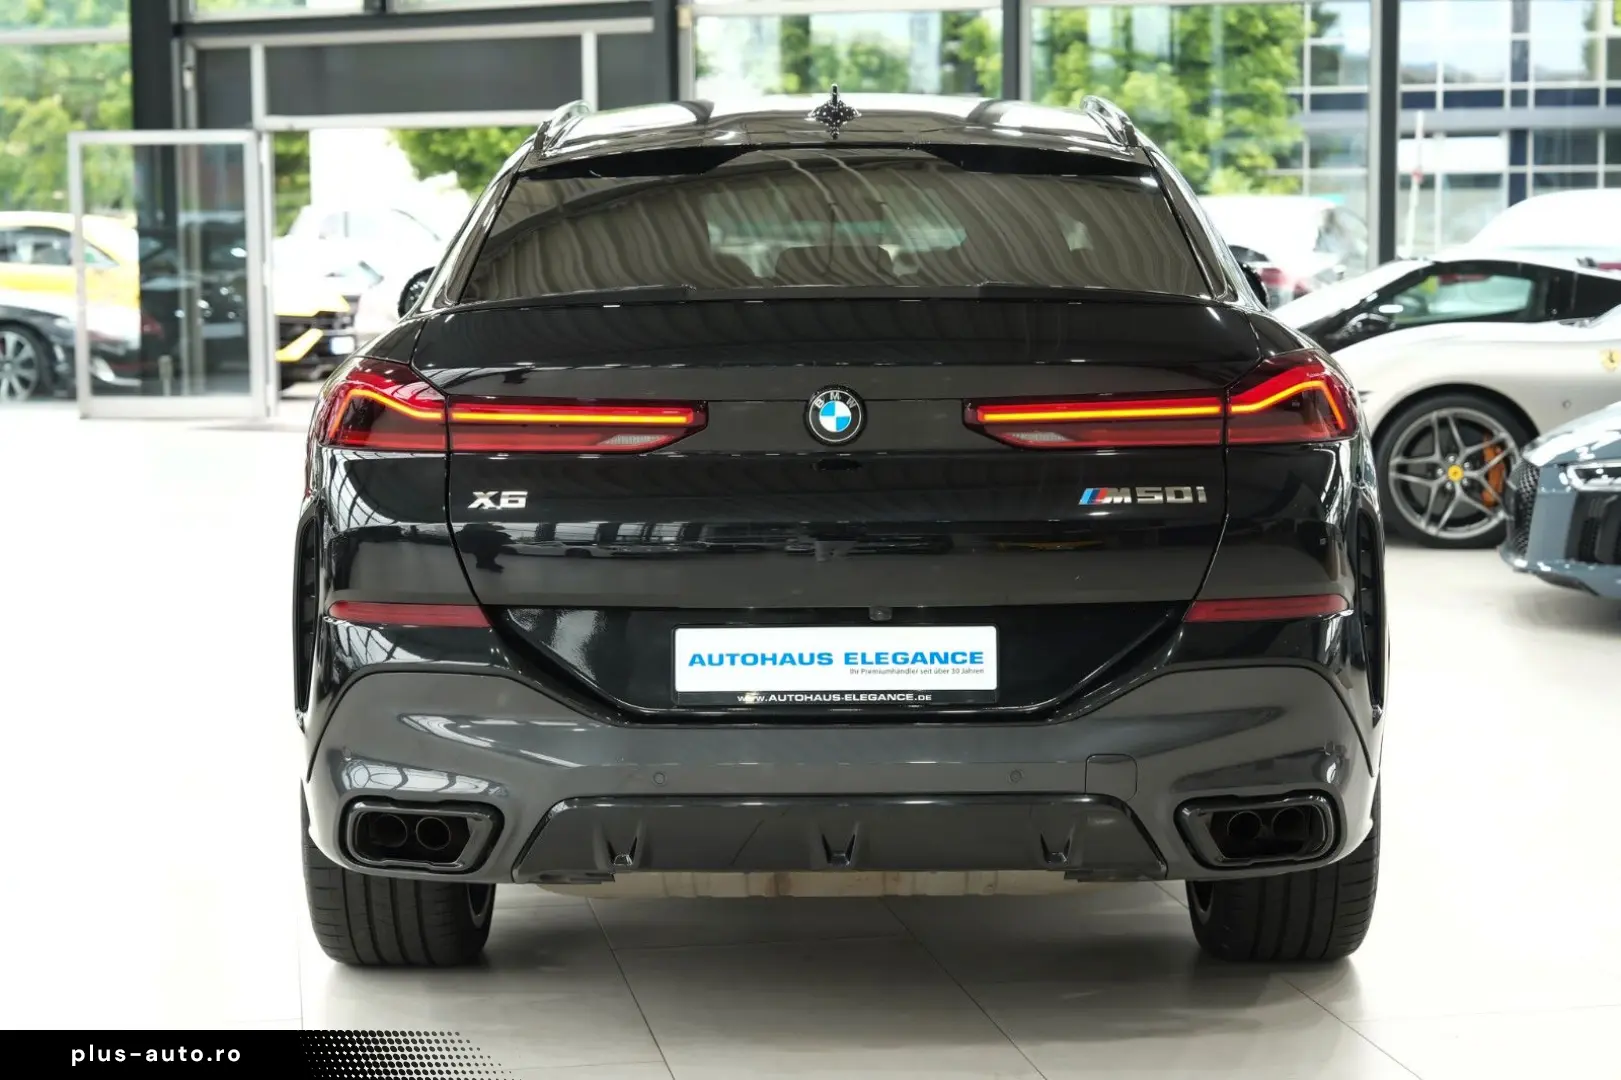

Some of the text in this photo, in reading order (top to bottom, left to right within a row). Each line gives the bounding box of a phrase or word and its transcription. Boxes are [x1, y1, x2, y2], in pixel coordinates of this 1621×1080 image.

[814, 391, 857, 409] BMW
[467, 490, 528, 509] X6
[688, 651, 985, 666] AUTOHAUS ELEGANCE
[737, 693, 932, 702] ww.AUTOHAUS-ELEGANCE.DE
